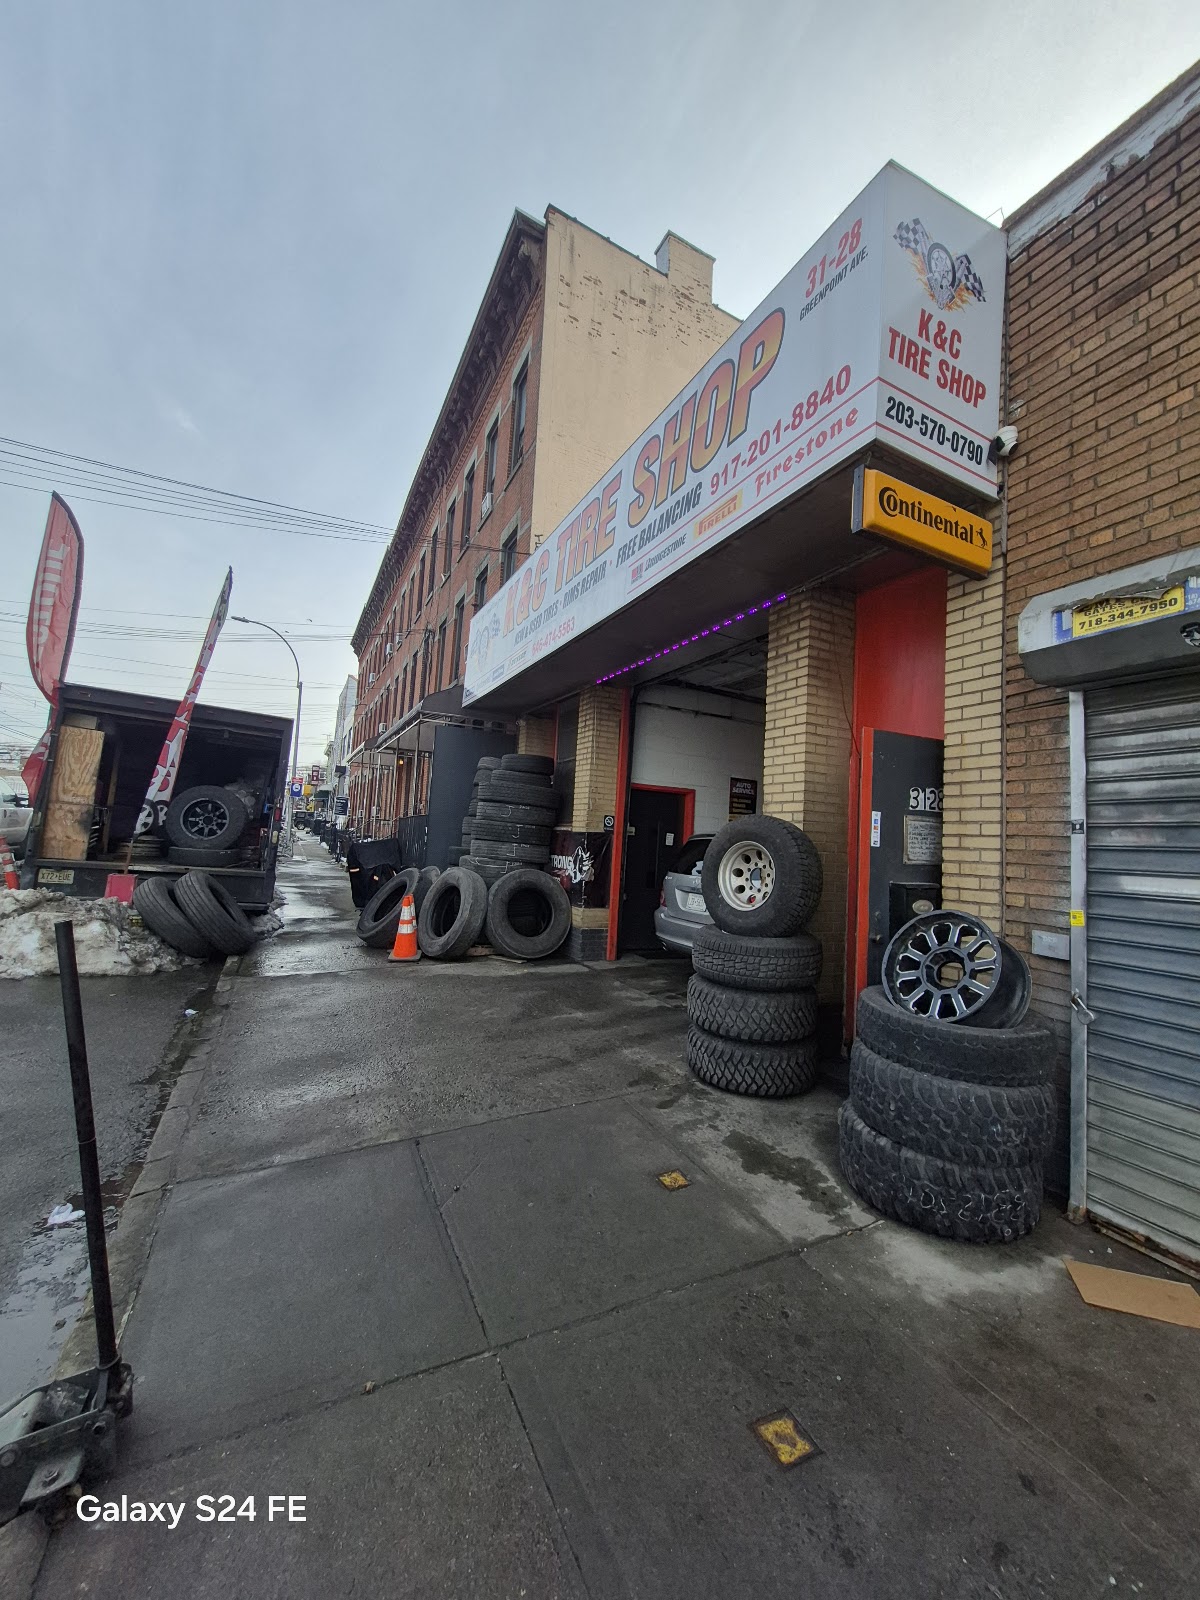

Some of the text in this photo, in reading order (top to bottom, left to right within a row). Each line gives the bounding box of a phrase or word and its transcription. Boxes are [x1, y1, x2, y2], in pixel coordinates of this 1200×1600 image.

[799, 245, 869, 322] GREENPOINT AVE.
[805, 217, 863, 299] 31-28
[888, 326, 987, 409] TIRE SHOP
[554, 469, 623, 596] TIRE
[627, 306, 786, 529] SHOP
[710, 364, 851, 496] 917-201-8840
[754, 407, 859, 498] Firestone
[885, 396, 983, 466] 203-570-0790
[542, 599, 560, 624] TIRES
[562, 585, 581, 609] RIMS
[579, 560, 608, 597] REPAIR
[615, 535, 639, 569] FREE
[637, 481, 703, 552] BALANCING
[697, 494, 739, 537] PIRELLI
[878, 486, 974, 545] Continental
[1079, 597, 1178, 630] 718-344-7950
[551, 855, 574, 871] TRONG
